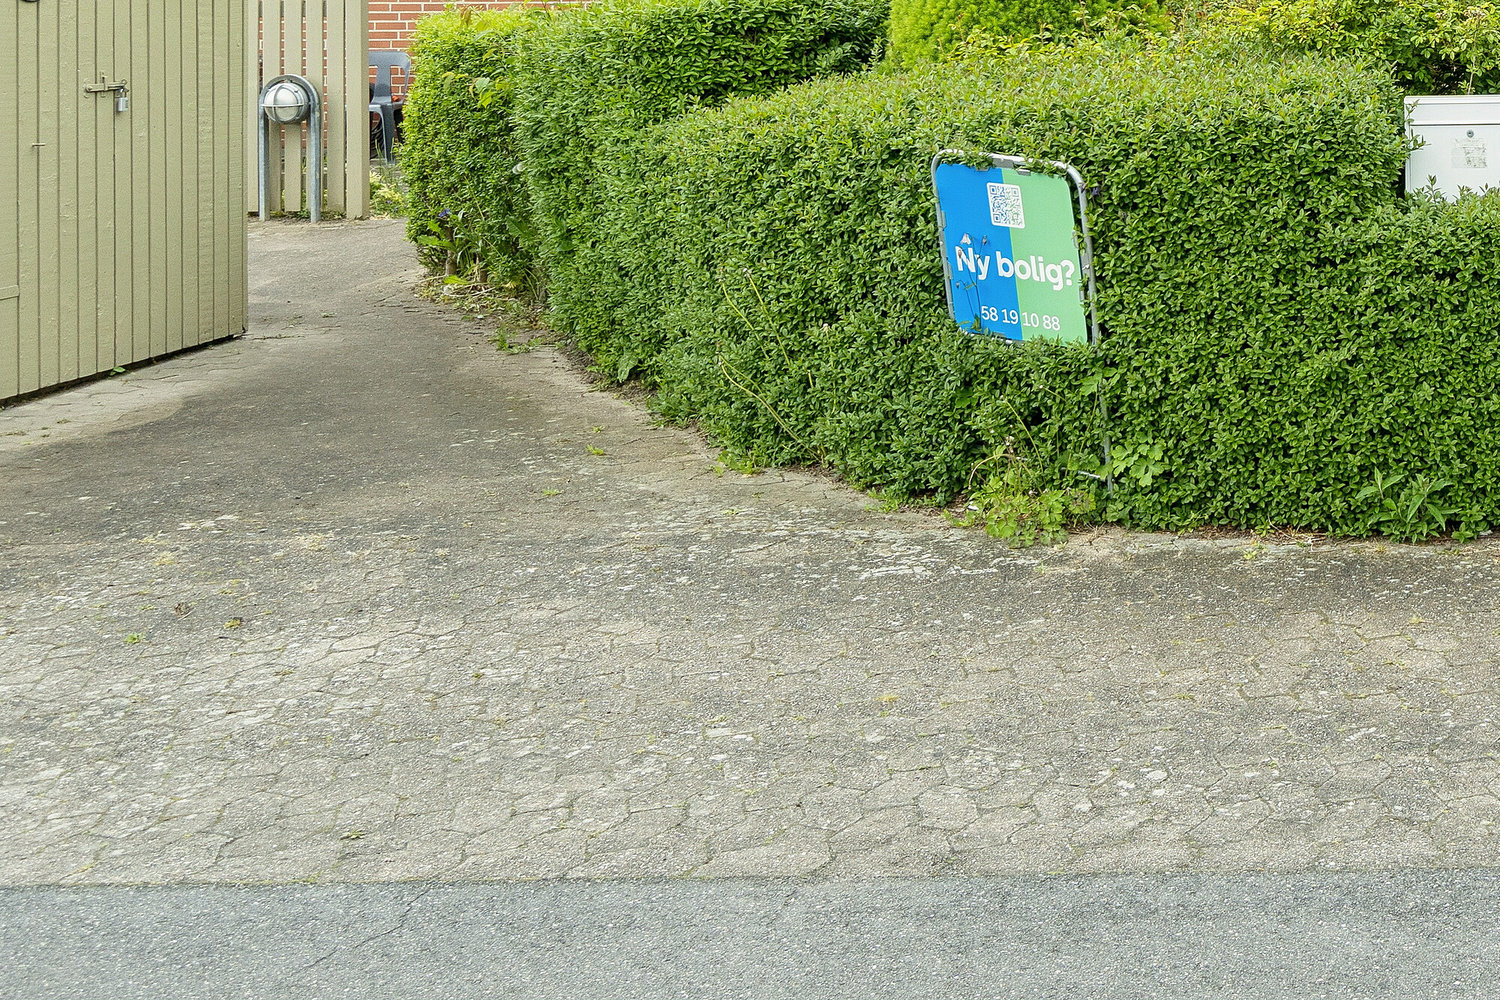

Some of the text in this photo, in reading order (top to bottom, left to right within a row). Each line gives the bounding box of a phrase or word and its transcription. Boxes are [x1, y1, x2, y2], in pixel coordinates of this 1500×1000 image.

[954, 246, 1076, 291] Ny bolig?
[981, 305, 1061, 331] 58 19 10 88
